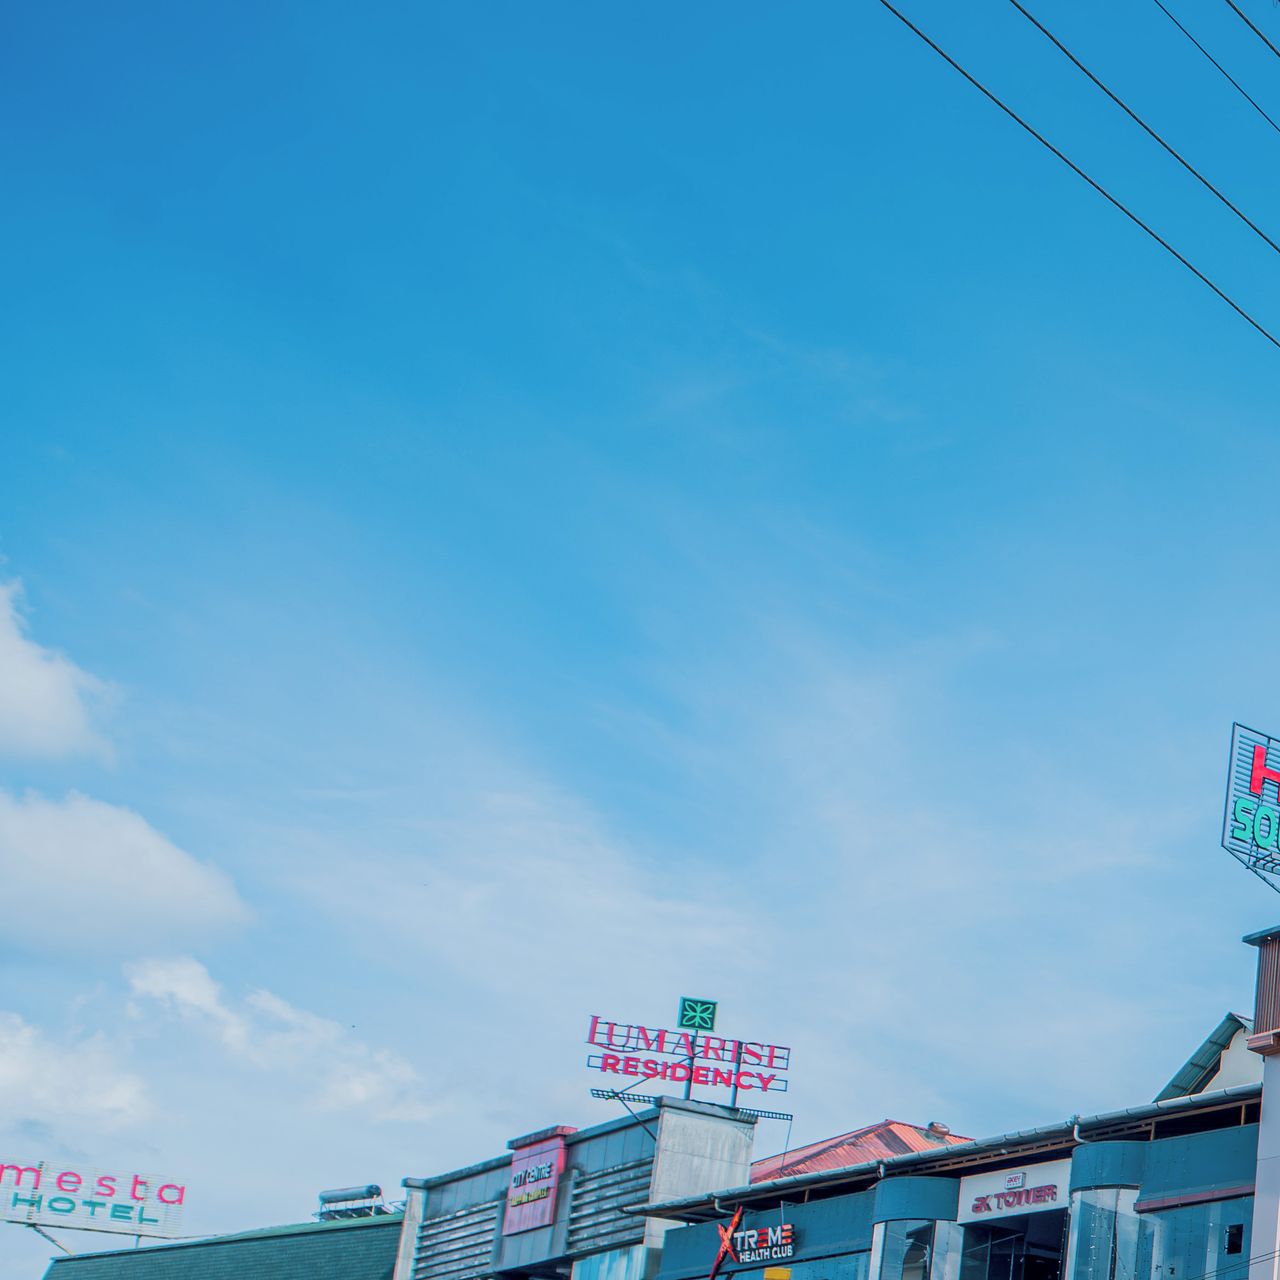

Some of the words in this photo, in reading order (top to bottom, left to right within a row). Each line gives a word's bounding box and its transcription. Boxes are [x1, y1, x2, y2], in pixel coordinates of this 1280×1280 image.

[585, 1014, 789, 1069] LUMARISE
[601, 1053, 776, 1092] RESIDENCY
[11, 1191, 159, 1225] HOTEL
[994, 1184, 1057, 1209] TOWER
[740, 1248, 770, 1263] HEALTH
[771, 1245, 793, 1259] CLUB
